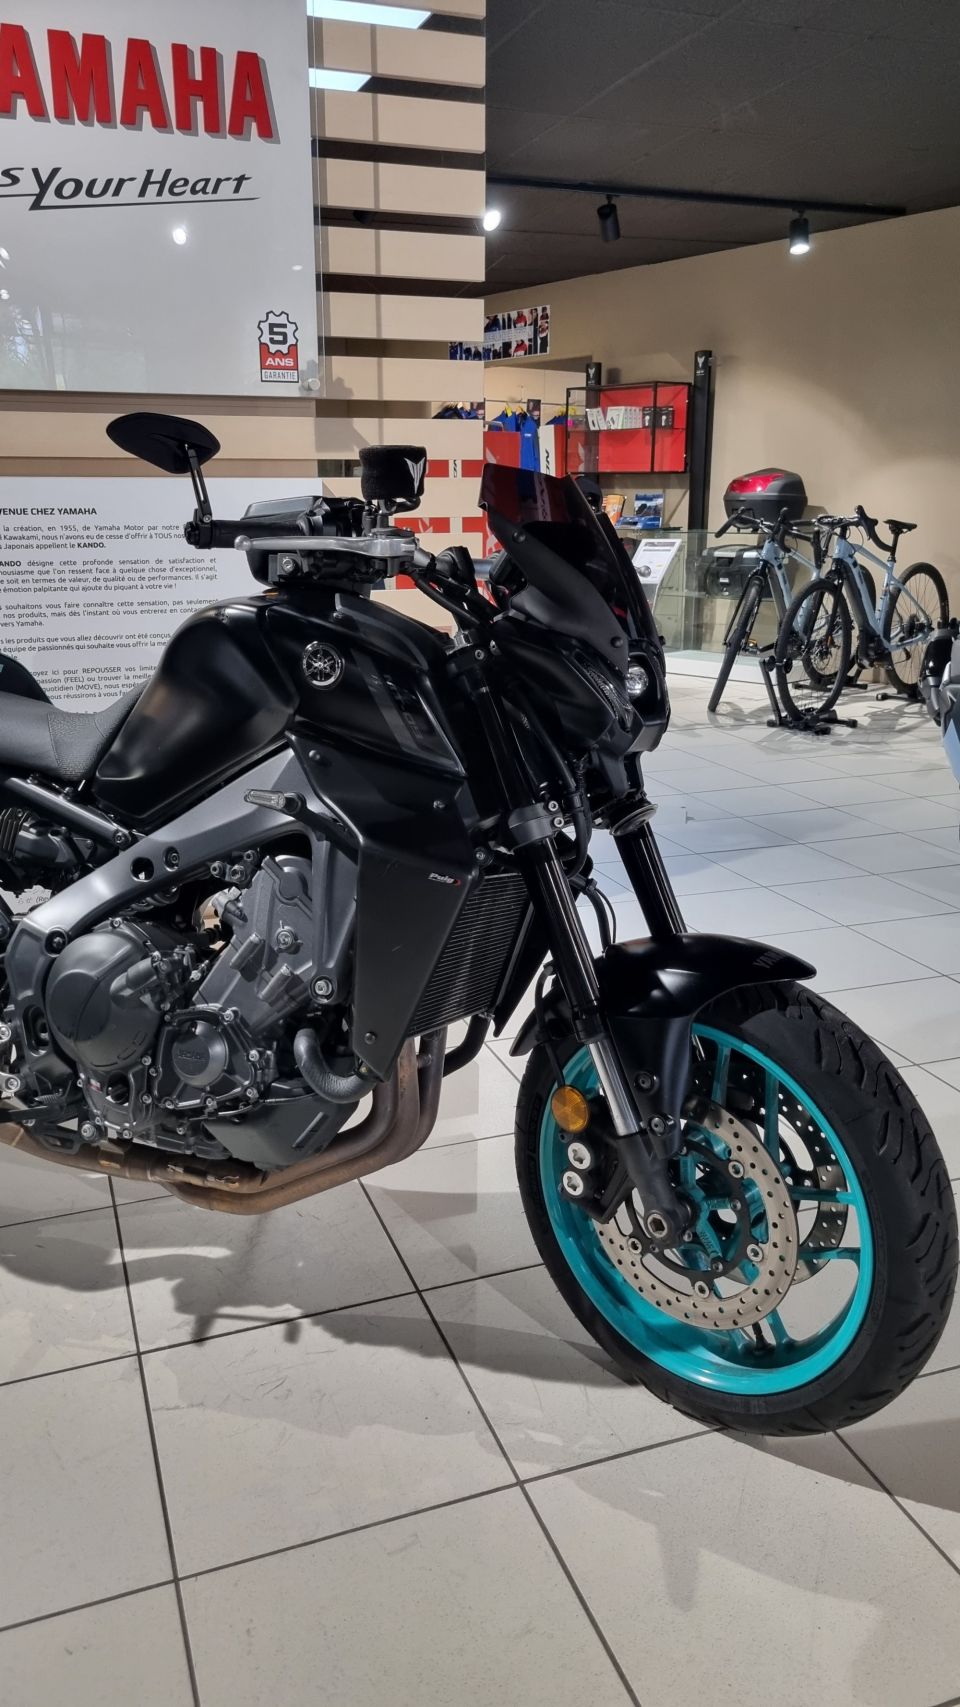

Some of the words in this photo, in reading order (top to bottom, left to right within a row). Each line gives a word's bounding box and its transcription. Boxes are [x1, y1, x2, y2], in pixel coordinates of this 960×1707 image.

[29, 167, 137, 211] Your
[138, 168, 252, 198] Heart
[268, 322, 288, 345] 5
[265, 357, 294, 366] ANS
[264, 371, 297, 380] GARANTIE
[31, 507, 55, 515] CHEZ
[57, 507, 97, 515] YAMAHA
[60, 524, 78, 532] 1955,
[27, 559, 54, 567] désigne
[83, 558, 113, 566] profonde
[201, 573, 217, 581] s'agit
[70, 584, 79, 592] qui
[82, 584, 102, 592] ajoute
[18, 611, 48, 619] produits,
[17, 636, 44, 644] produits
[77, 634, 91, 642] allez
[94, 633, 124, 641] découvrir
[3, 645, 26, 653] équipe
[63, 669, 78, 677] pour
[82, 666, 121, 674] REPOUSSER
[64, 676, 84, 684] (FEEL)
[75, 684, 103, 692] (MOVE),
[64, 692, 96, 700] réussirons
